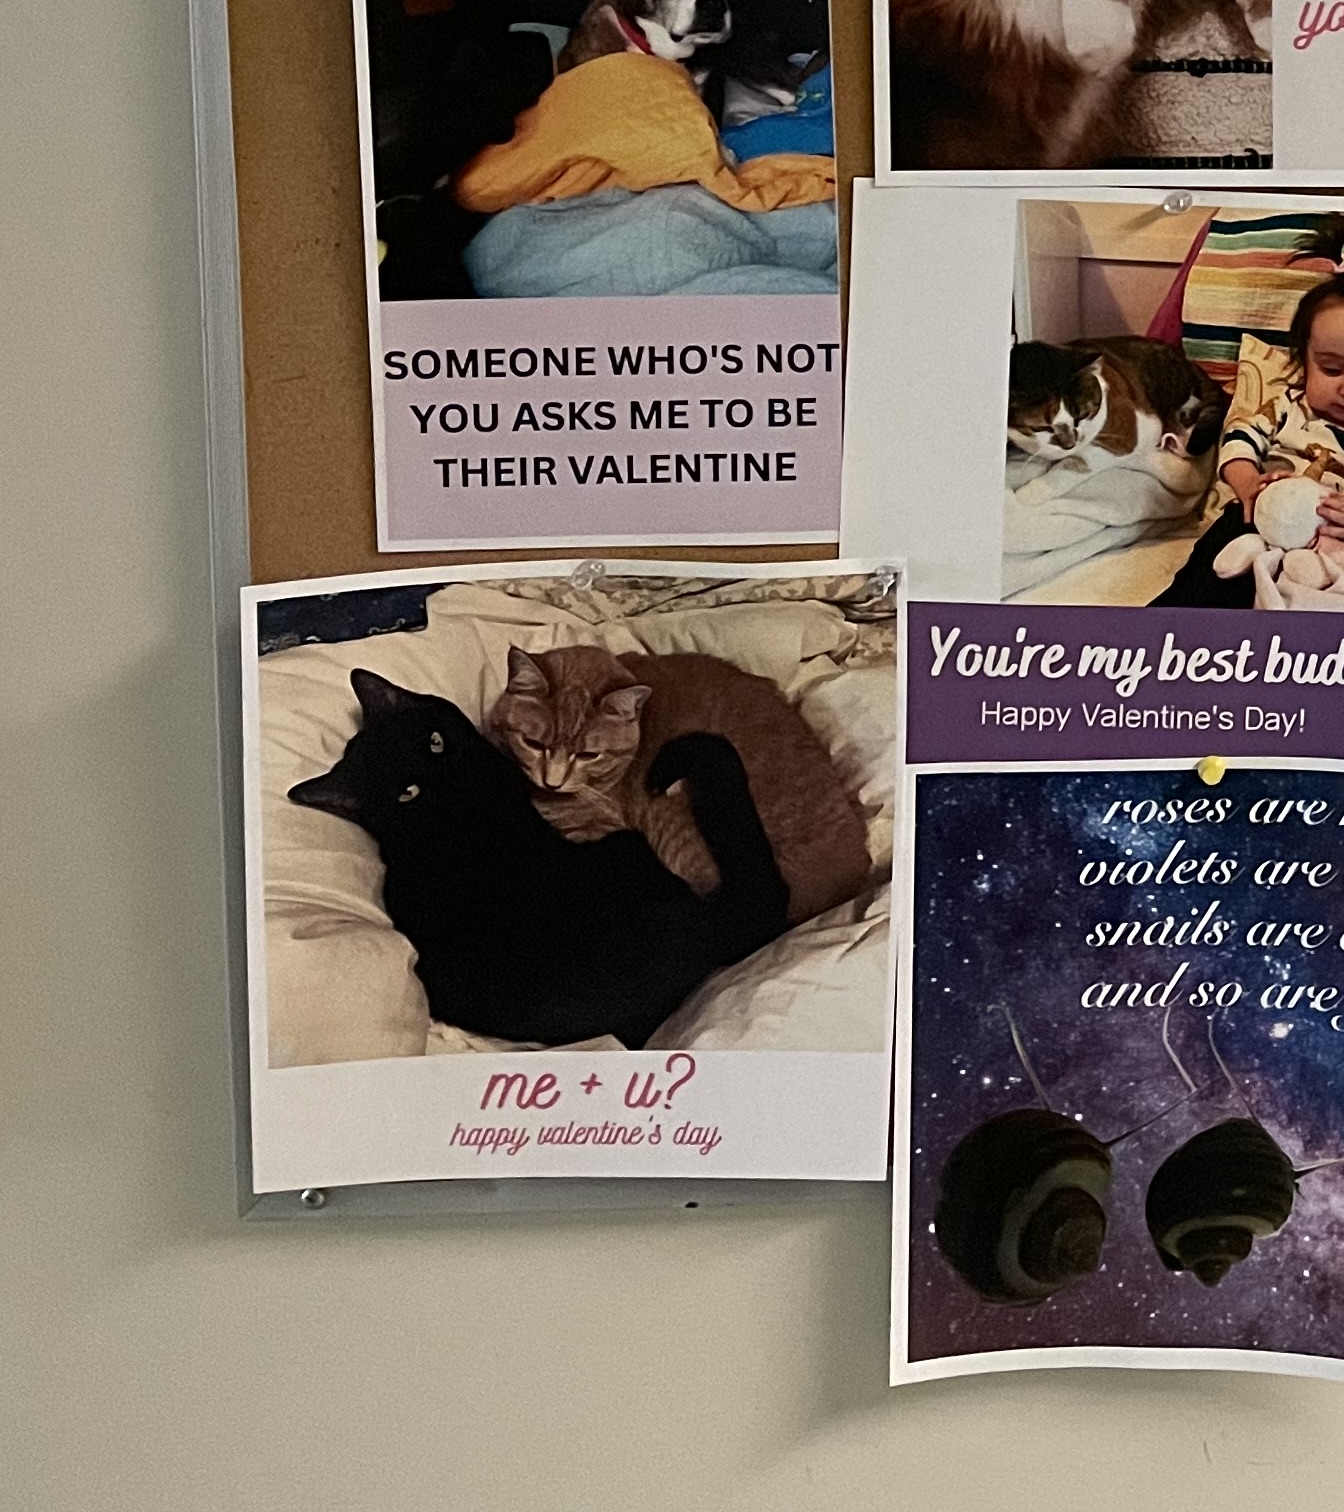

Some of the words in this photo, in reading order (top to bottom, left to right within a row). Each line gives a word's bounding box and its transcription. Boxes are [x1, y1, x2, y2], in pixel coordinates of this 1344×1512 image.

[383, 346, 597, 380] SOMEONE
[607, 344, 744, 376] WHO'S
[756, 343, 840, 373] NOT
[410, 403, 499, 433] YOU
[512, 401, 617, 432] ASKS
[630, 399, 689, 429] ME
[699, 399, 754, 428] TO
[767, 398, 817, 427] BE
[433, 456, 557, 488] THEIR
[567, 452, 797, 485] VALENTINE
[930, 625, 1073, 679] You're
[1077, 645, 1152, 698] my
[1157, 632, 1259, 683] best
[981, 701, 1072, 732] Happy
[1083, 703, 1234, 731] Valentine's
[1244, 706, 1306, 737] Day!
[1102, 797, 1236, 825] roses
[1249, 797, 1334, 826] are
[1079, 840, 1242, 886] violets
[1254, 859, 1338, 887] are
[1085, 900, 1234, 947] snails
[1246, 920, 1333, 949] are
[1080, 961, 1190, 1009] and
[1188, 980, 1250, 1008] so
[1259, 984, 1344, 1012] are
[480, 1072, 561, 1110] me
[624, 1052, 696, 1110] u?
[449, 1123, 530, 1156] happy
[537, 1115, 662, 1145] valentine's
[672, 1121, 722, 1155] day
